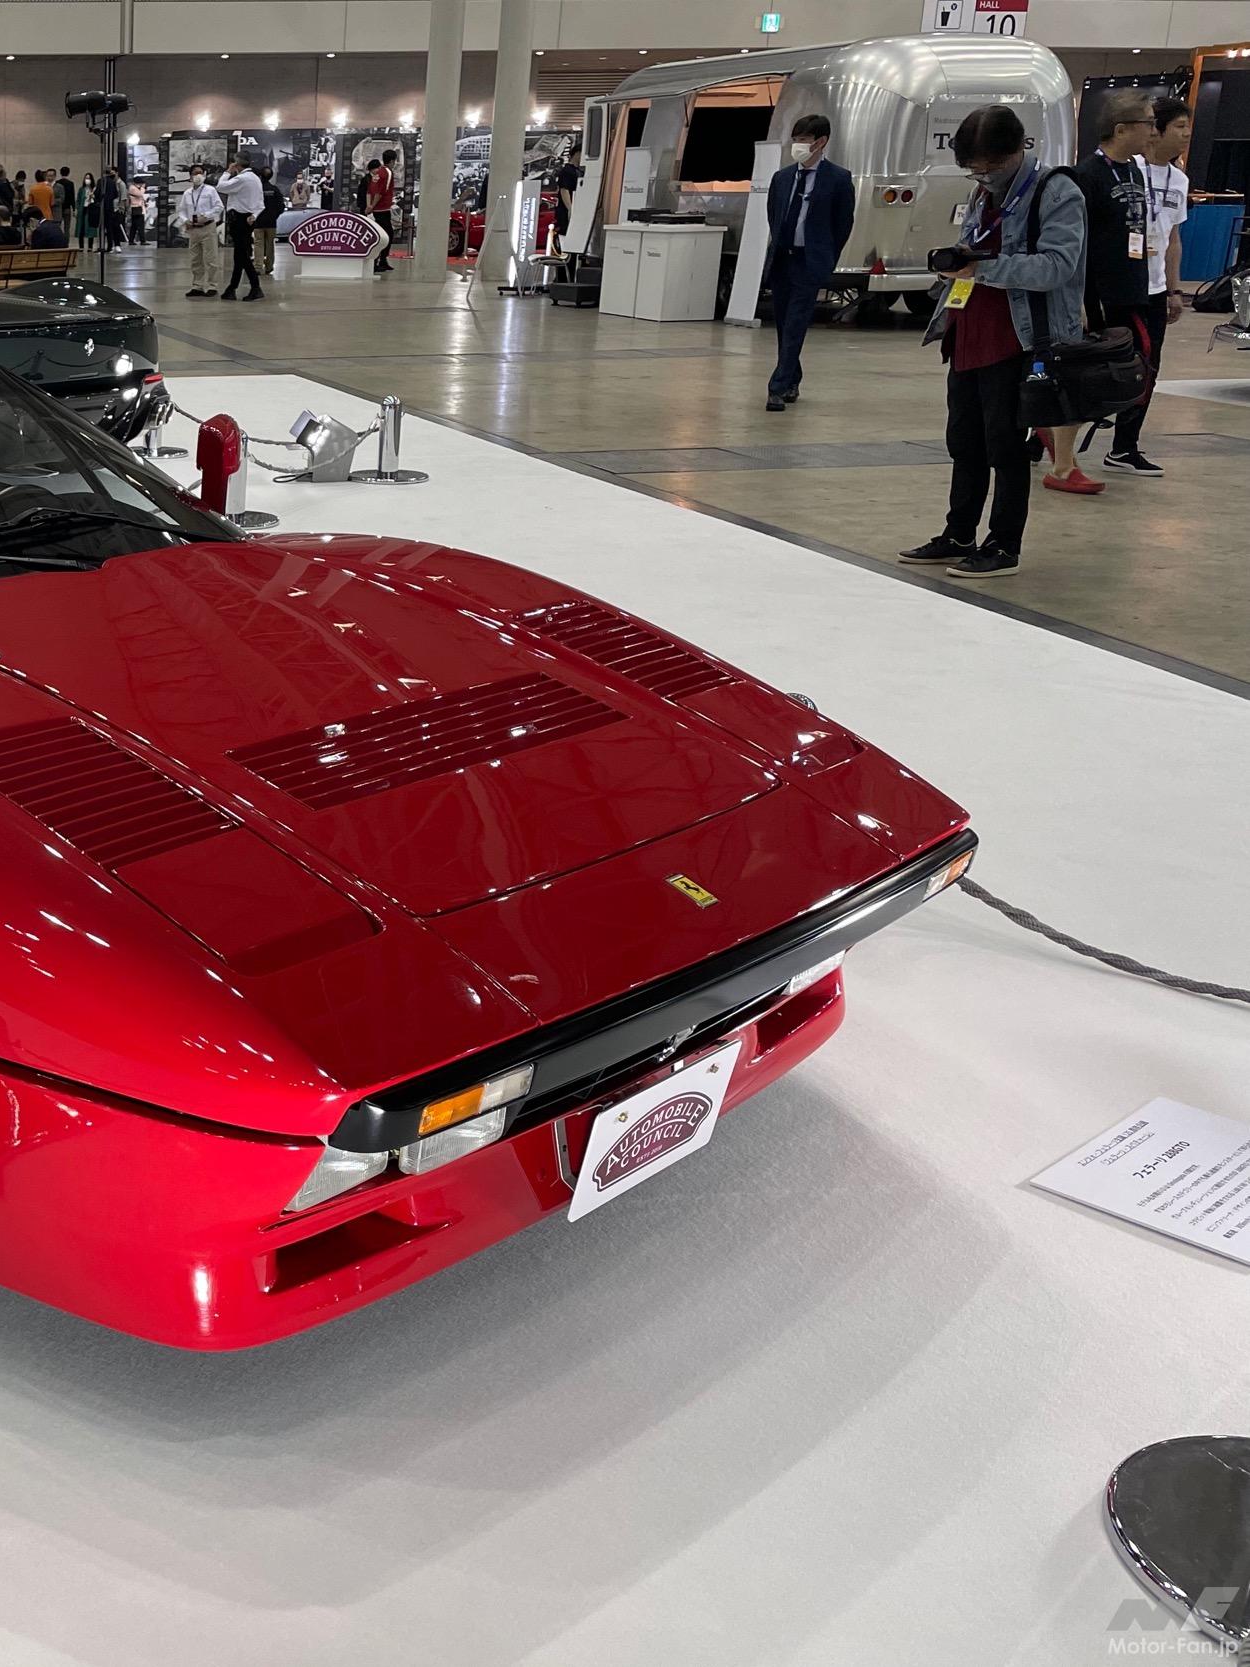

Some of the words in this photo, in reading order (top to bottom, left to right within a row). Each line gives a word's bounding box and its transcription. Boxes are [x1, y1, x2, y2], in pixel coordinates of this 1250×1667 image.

[979, 0, 1000, 9] HALL
[986, 14, 1016, 36] 10
[297, 217, 373, 247] AUTOMOBILE
[308, 232, 356, 249] COUNCIL
[605, 1101, 704, 1176] AUTOMOBILE
[621, 1123, 683, 1168] COUNCIL
